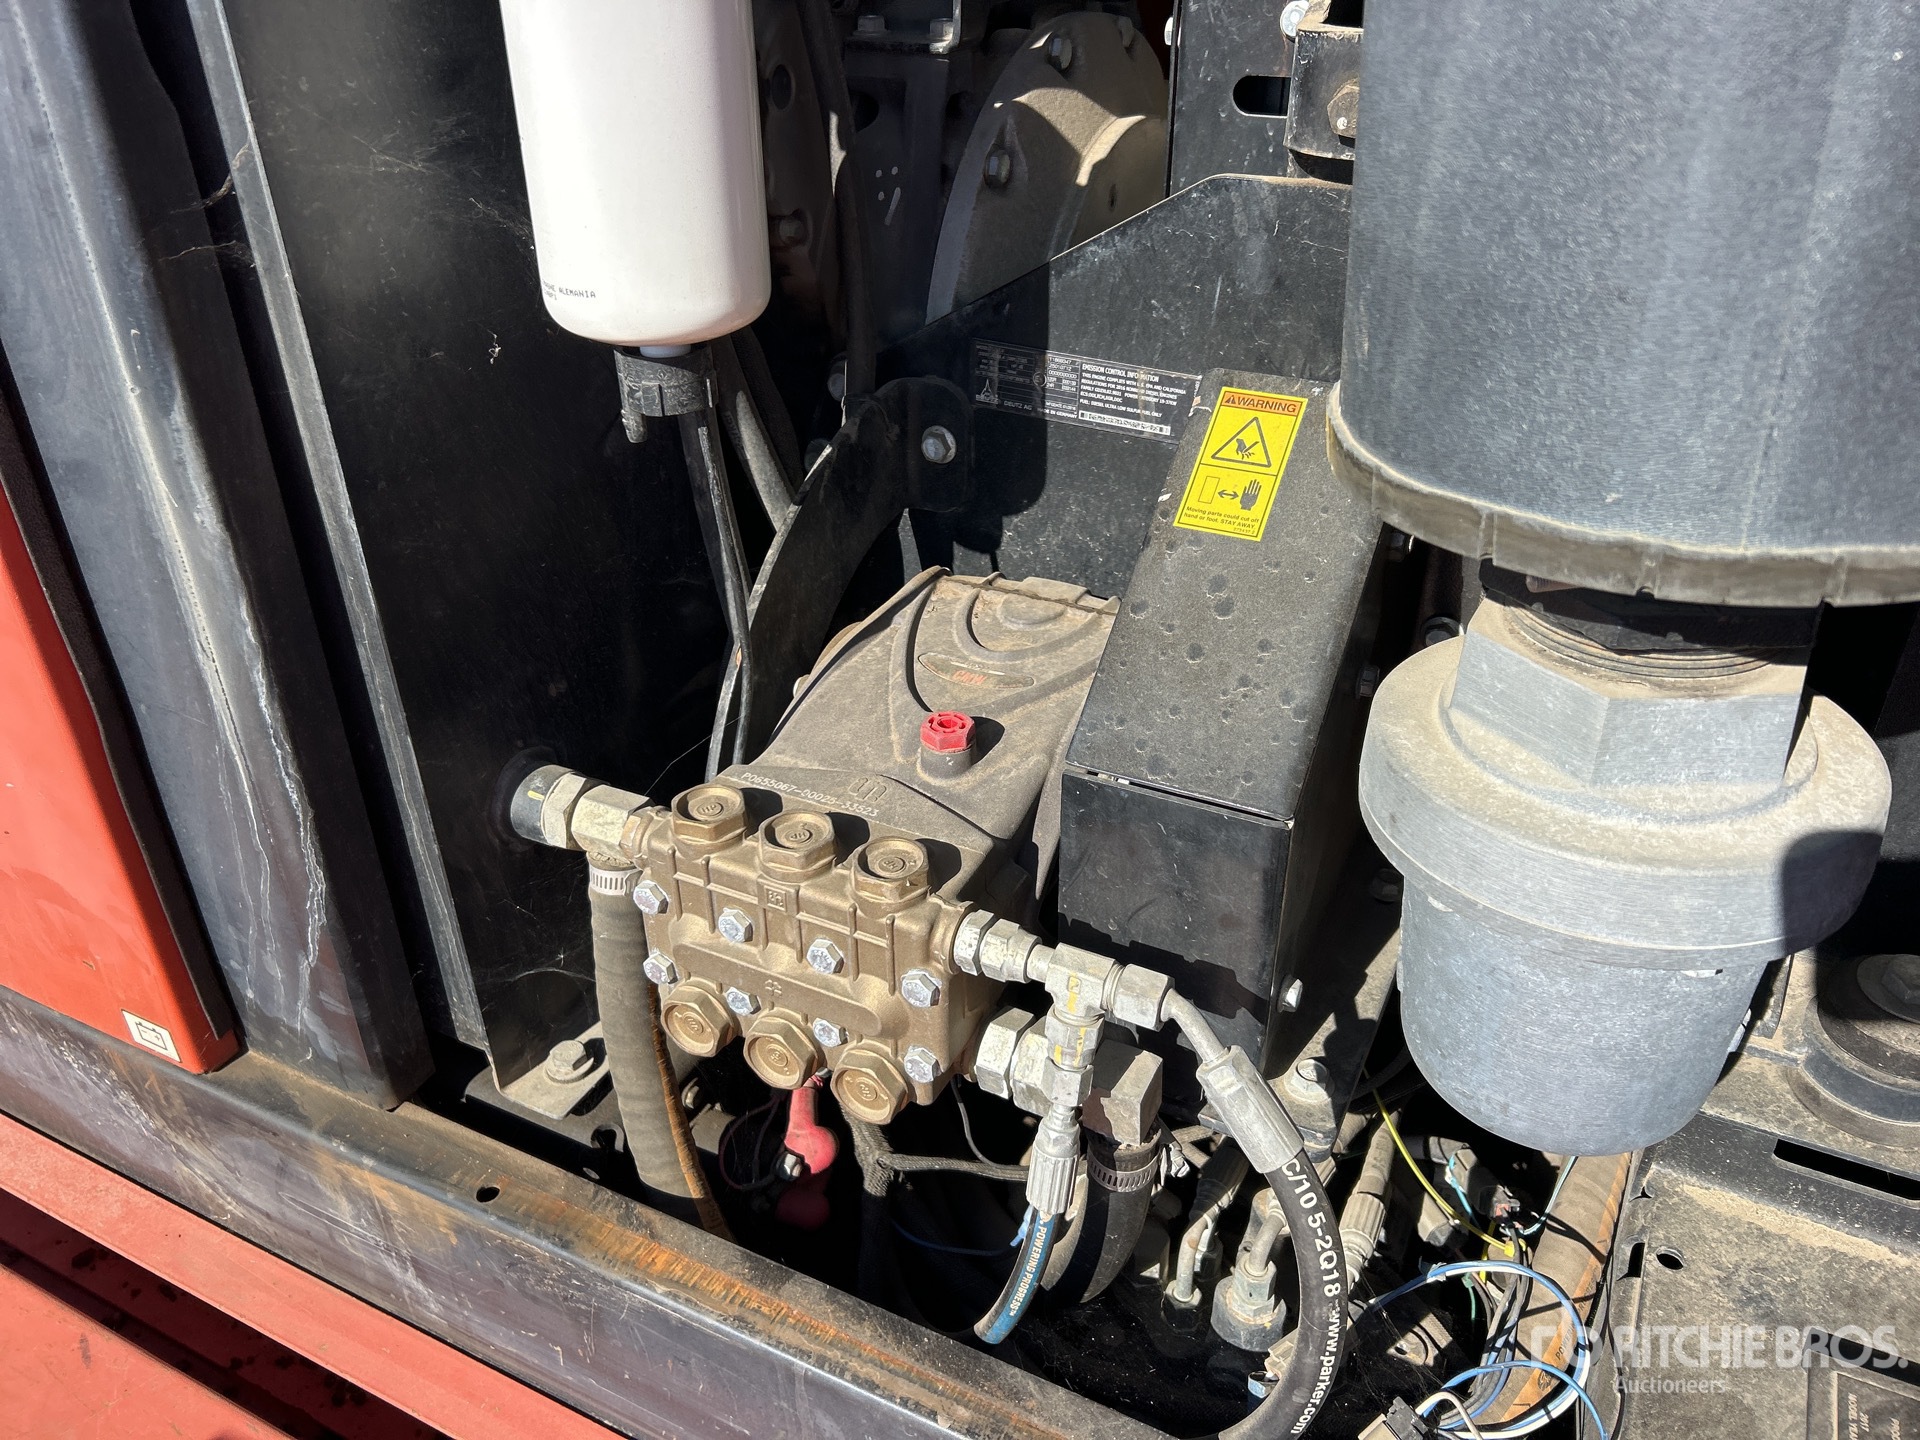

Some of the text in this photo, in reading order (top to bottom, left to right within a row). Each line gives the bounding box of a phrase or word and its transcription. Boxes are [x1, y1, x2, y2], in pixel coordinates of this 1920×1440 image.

[558, 287, 596, 298] ALEMANIA
[1105, 368, 1126, 378] CONTROL
[1163, 386, 1186, 395] CALIFORNIA
[1237, 397, 1297, 413] WARNING
[1184, 512, 1198, 520] hand
[1186, 506, 1207, 515] Moving
[1223, 511, 1240, 520] could
[1240, 514, 1250, 522] cut
[1027, 1223, 1048, 1274] POWERING
[1307, 1211, 1342, 1298] 5-2Q18
[1847, 1392, 1859, 1440] MODEL YEA
